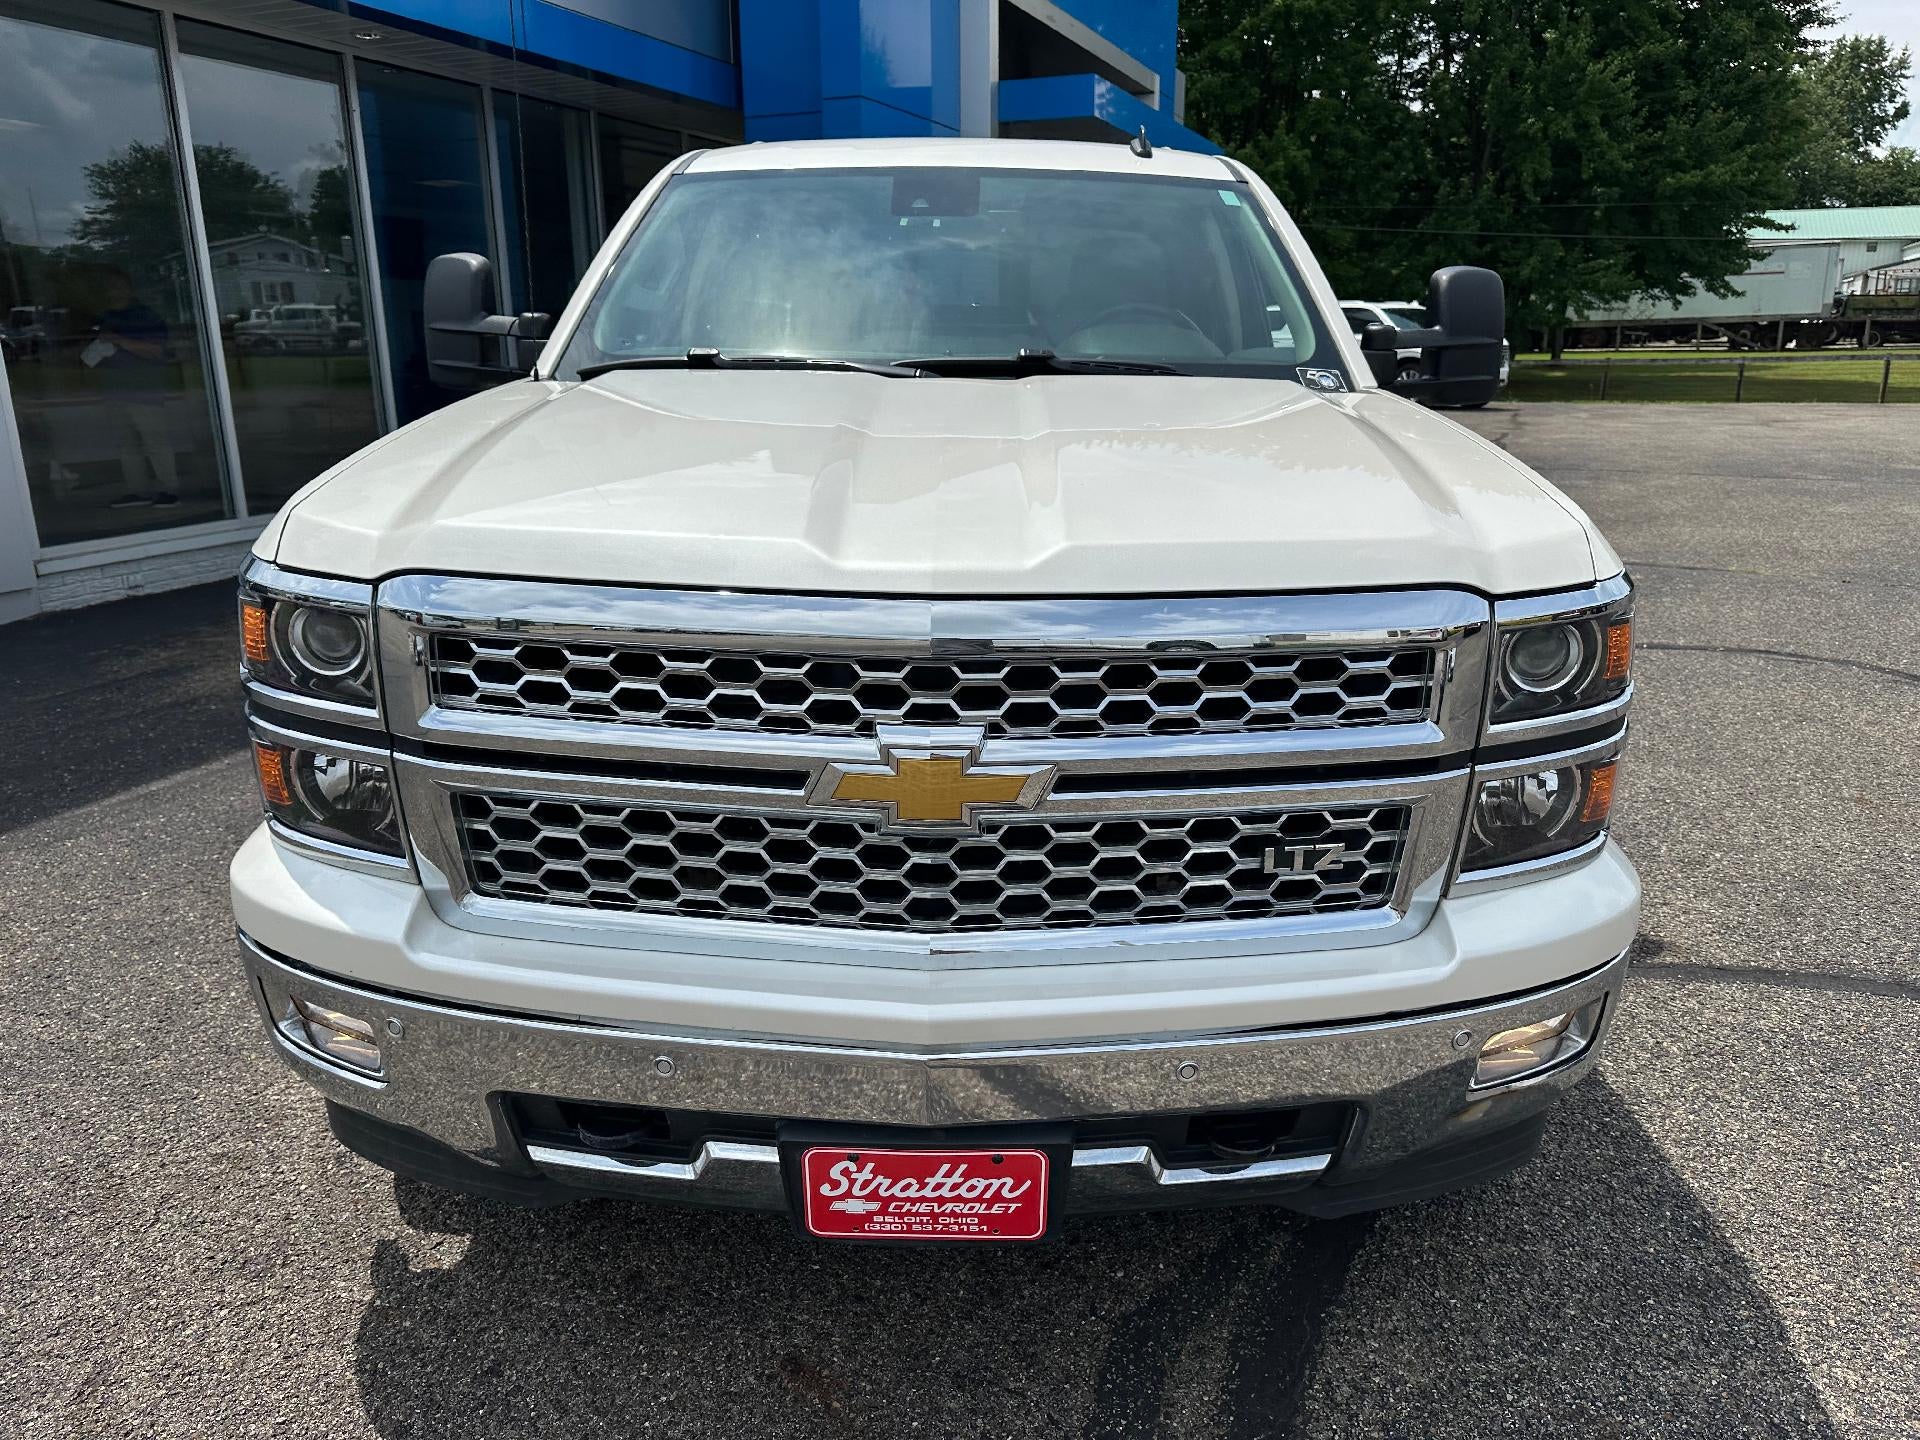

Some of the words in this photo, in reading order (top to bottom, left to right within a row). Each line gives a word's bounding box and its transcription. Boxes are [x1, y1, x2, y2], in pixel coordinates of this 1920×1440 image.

[1263, 843, 1346, 874] LTZ
[819, 1160, 1032, 1199] Stratton
[887, 1201, 1022, 1214] CHEVROLET
[873, 1215, 933, 1224] BELOIT,
[938, 1216, 979, 1224] OHIO
[864, 1223, 907, 1232] (330)
[911, 1224, 988, 1232] 537-3151
